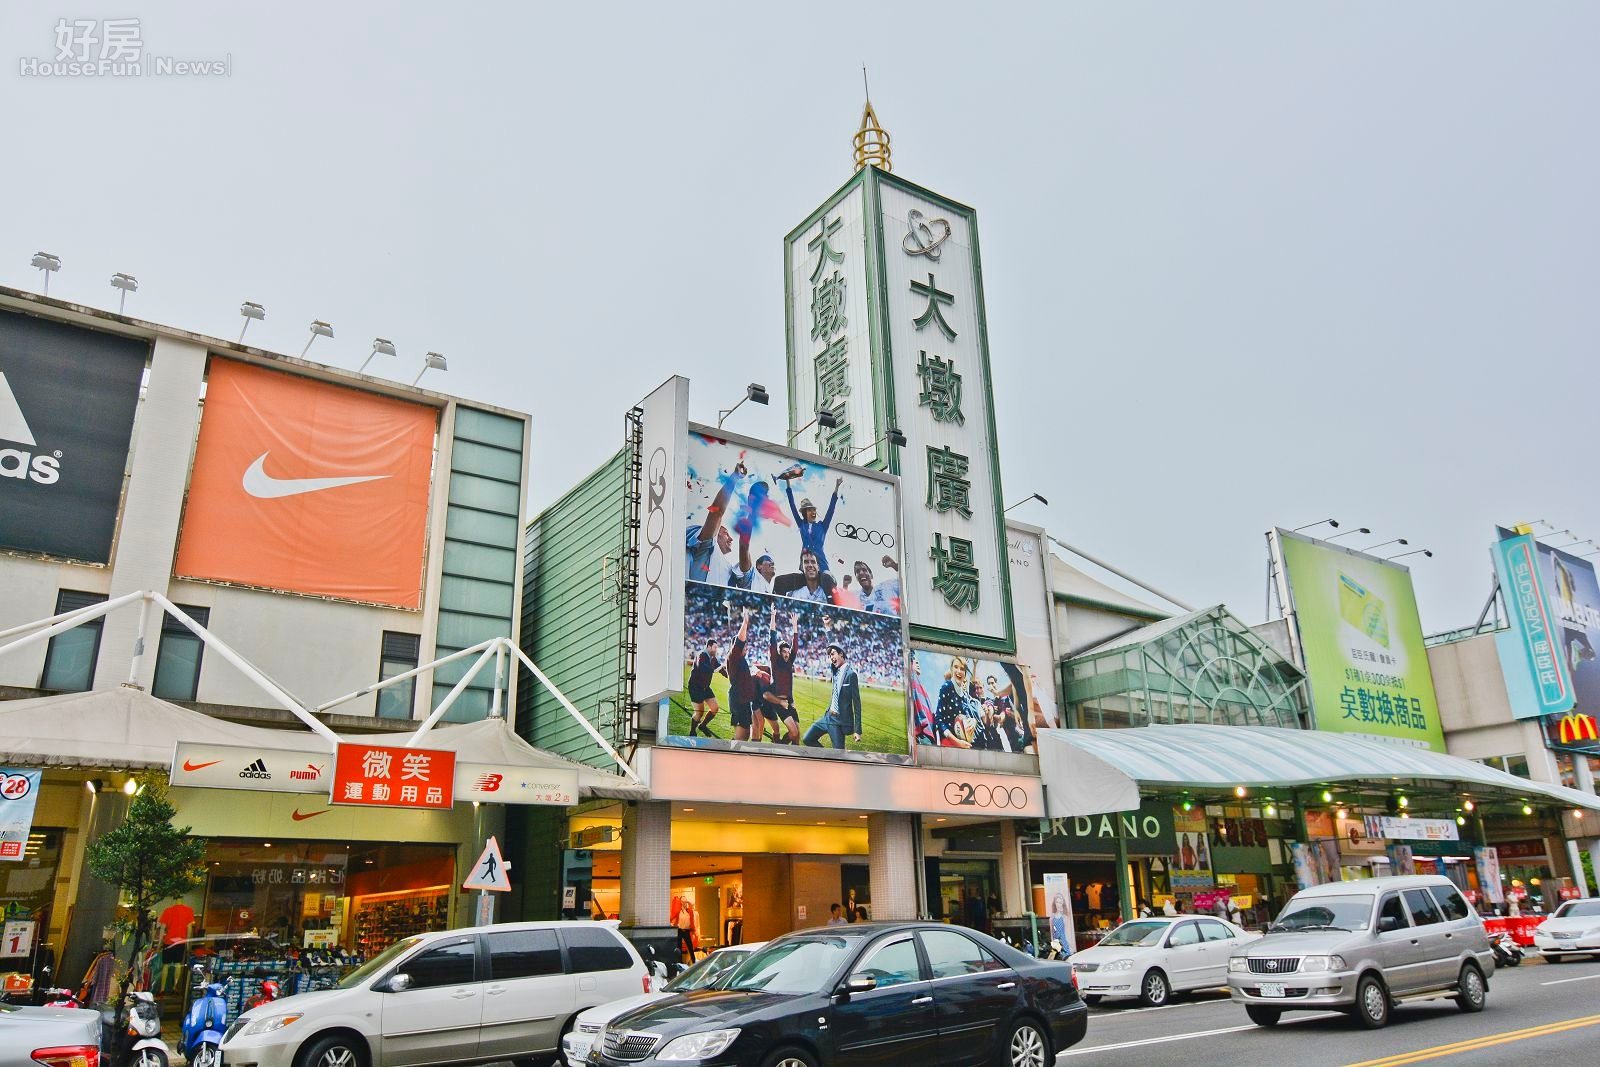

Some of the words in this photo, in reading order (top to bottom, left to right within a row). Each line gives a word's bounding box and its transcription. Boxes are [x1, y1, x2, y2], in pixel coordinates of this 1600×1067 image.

[909, 272, 980, 614] 大墩廣場
[643, 446, 667, 627] G2000
[835, 522, 895, 549] G2000
[239, 771, 272, 780] adidas
[290, 770, 317, 781] PUMA
[361, 750, 432, 782] 微笑
[5, 779, 26, 794] 28
[344, 782, 443, 804] 運動用品
[944, 782, 1028, 809] G2000
